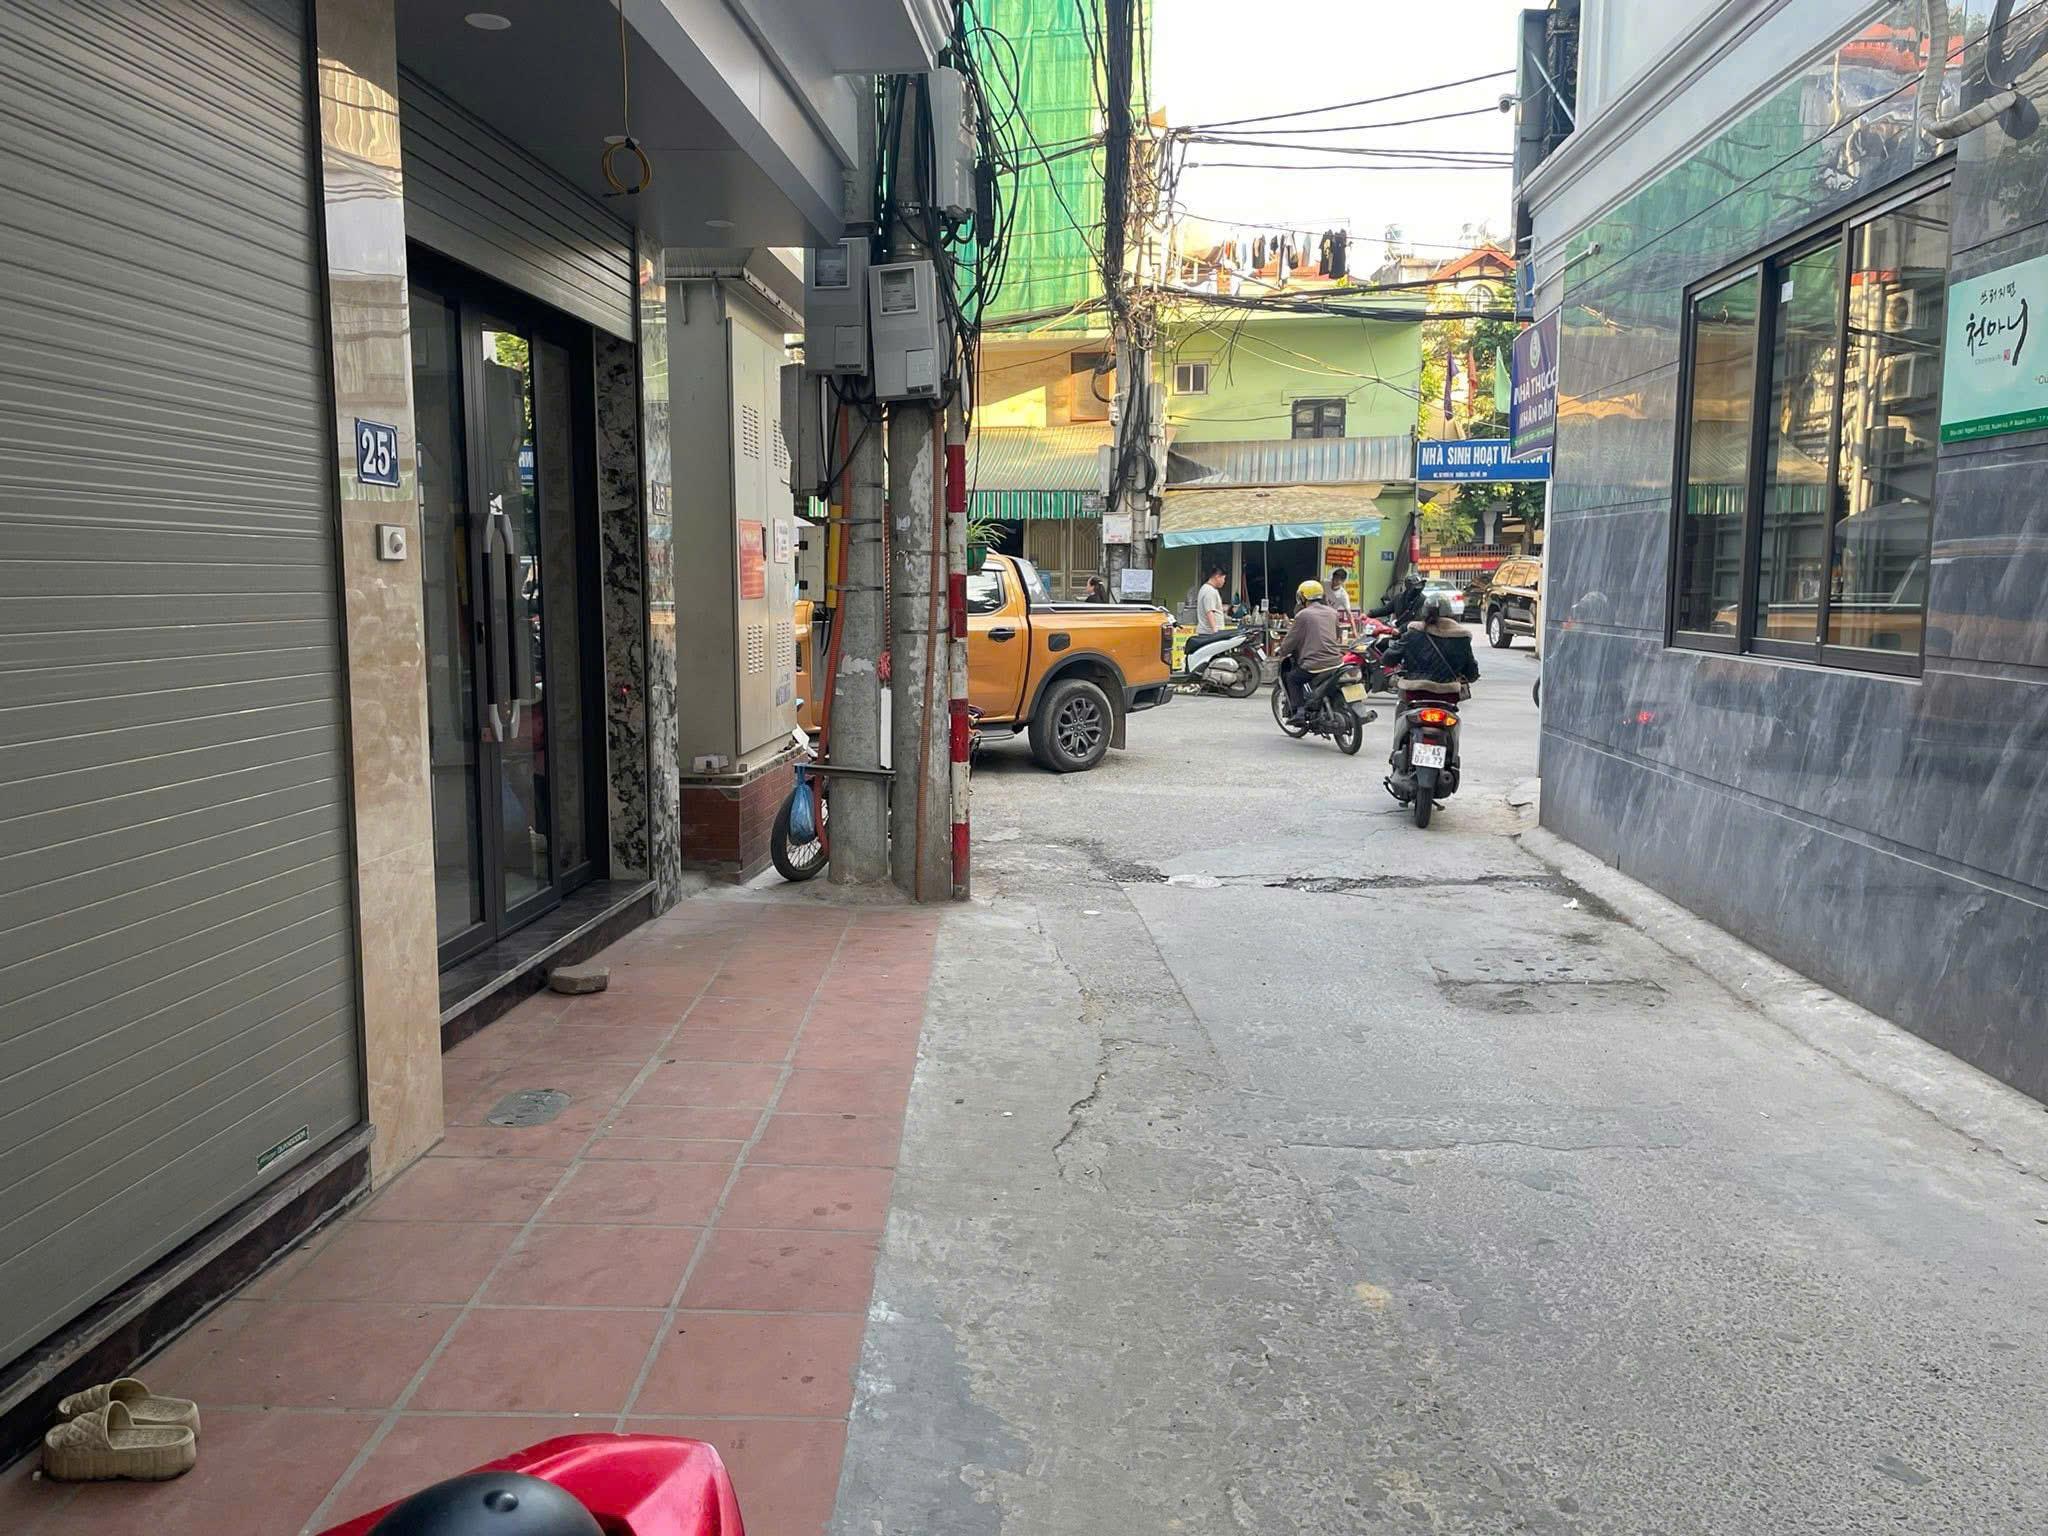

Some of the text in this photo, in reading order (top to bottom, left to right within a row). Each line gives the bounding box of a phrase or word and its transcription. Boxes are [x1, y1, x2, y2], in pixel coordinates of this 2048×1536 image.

[1966, 298, 2028, 366] 천마니
[1422, 444, 1443, 465] NHÀ
[1447, 446, 1471, 465] SINH
[1473, 446, 1499, 467] HOẠT
